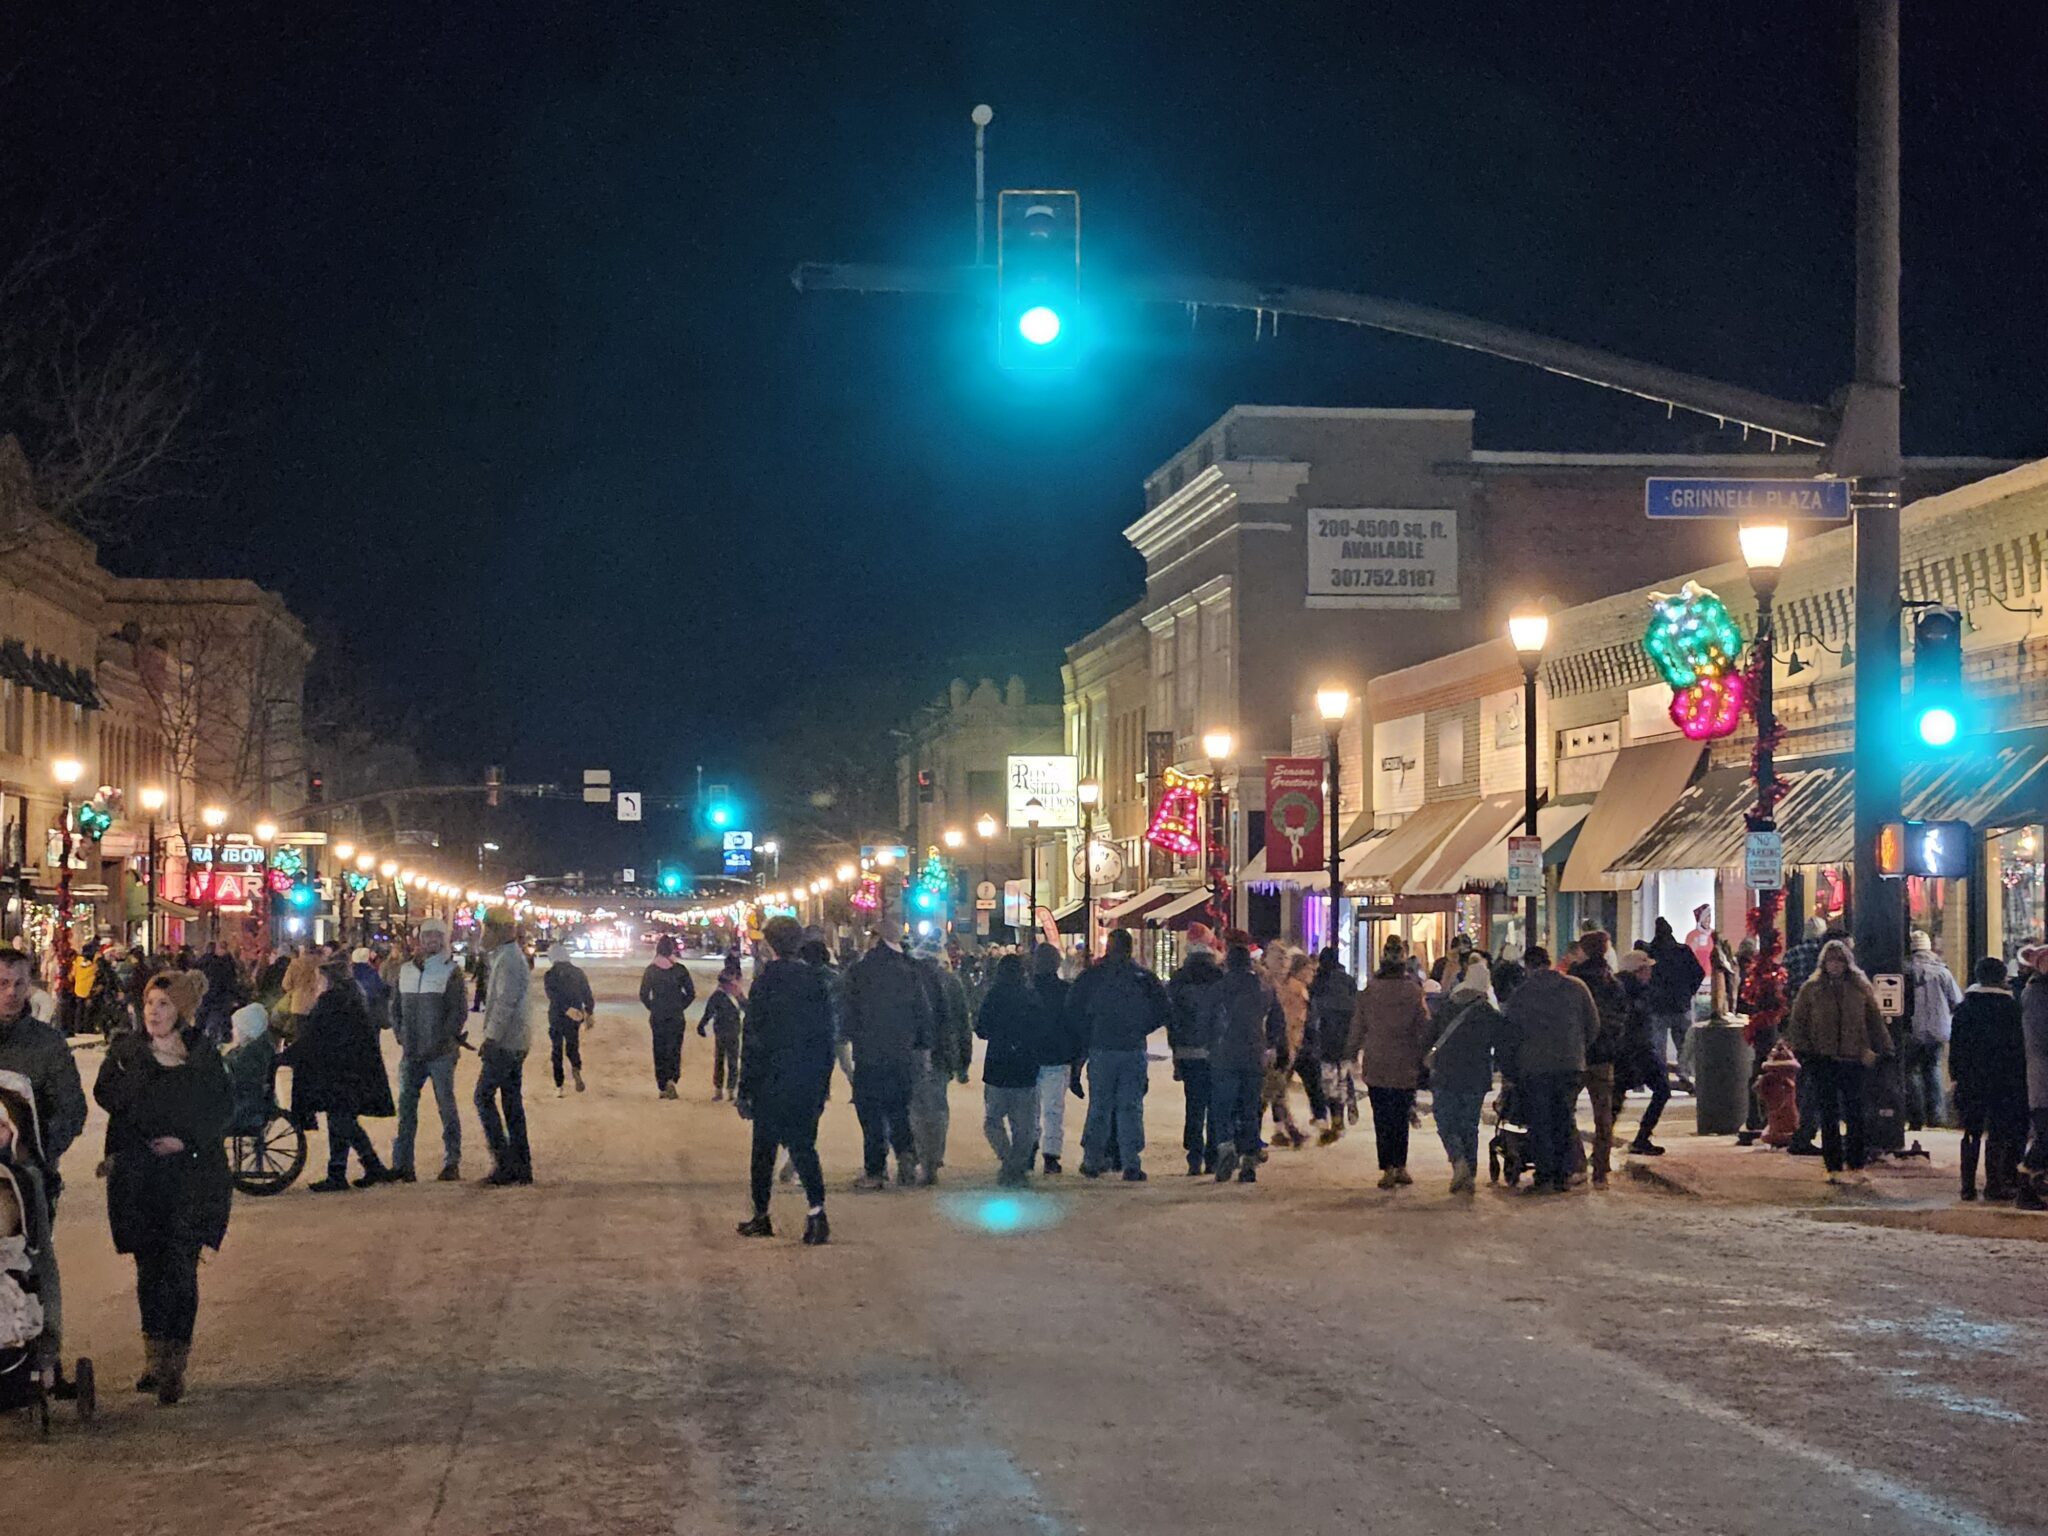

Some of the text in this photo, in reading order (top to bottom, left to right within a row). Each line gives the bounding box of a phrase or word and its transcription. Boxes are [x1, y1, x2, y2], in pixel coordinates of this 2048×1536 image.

[1671, 488, 1824, 511] GRINNELL PLAZA
[1403, 522, 1427, 540] sq.
[1430, 520, 1448, 539] ft.
[1341, 541, 1425, 559] AVAILABLE
[1270, 776, 1319, 790] Greetings
[191, 847, 265, 863] RANBOW
